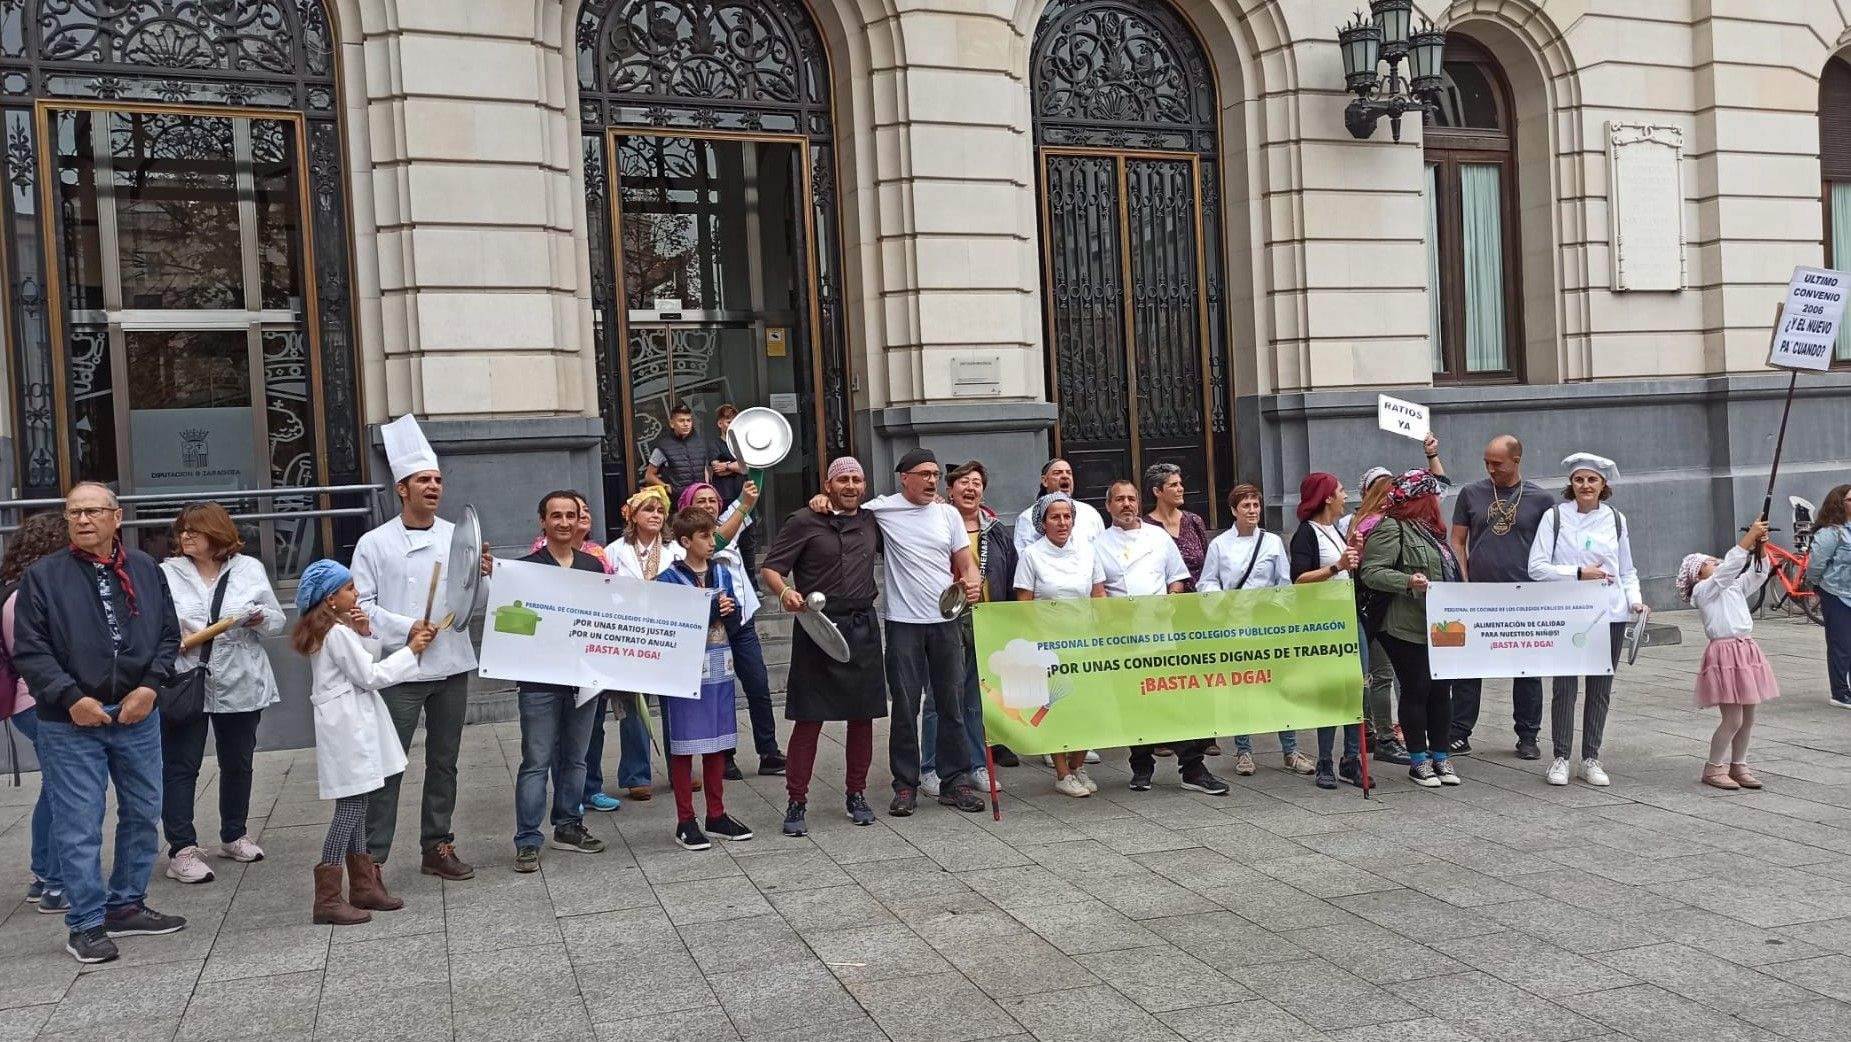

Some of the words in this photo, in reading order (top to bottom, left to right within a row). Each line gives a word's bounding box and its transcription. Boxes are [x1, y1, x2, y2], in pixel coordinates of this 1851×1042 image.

[1804, 274, 1838, 286] ULTIMO
[1794, 288, 1840, 301] CONVENIO
[1802, 304, 1824, 314] 2006
[1796, 319, 1806, 331] EL
[1806, 320, 1832, 334] NUEVO
[1792, 341, 1826, 357] CUANDO?
[1384, 402, 1422, 419] RATIOS
[1398, 420, 1410, 430] YA
[526, 602, 556, 612] PERSONAL
[566, 607, 592, 616] COCINAS
[614, 613, 641, 622] COLEGIOS
[573, 618, 592, 628] ¡POR
[594, 621, 615, 631] UNAS
[617, 624, 646, 634] RATIOS
[646, 627, 676, 638] JUSTAS!
[1037, 639, 1089, 650] PERSONAL
[1092, 637, 1104, 646] DE
[1106, 634, 1150, 645] COCINAS
[1152, 633, 1164, 642] DE
[1168, 632, 1186, 641] LOS
[1189, 629, 1236, 639] COLEGIOS
[1239, 626, 1286, 637] PÚBLICOS
[1288, 625, 1300, 633] DE
[1302, 620, 1345, 632] ARAGÓN
[569, 629, 588, 638] ¡POR
[590, 632, 602, 640] UN
[604, 634, 646, 645] CONTRATO
[648, 639, 677, 648] ANUAL!
[1490, 640, 1518, 650] ¡BASTA
[1520, 640, 1532, 648] YA
[1534, 640, 1554, 648] DGA!
[585, 644, 619, 655] ¡BASTA
[623, 648, 636, 657] YA
[638, 650, 661, 660] DGA!
[1047, 663, 1079, 678] ¡POR
[1083, 660, 1120, 672] UNAS
[1124, 653, 1216, 670] CONDICIONES
[1220, 649, 1270, 662] DIGNAS
[1274, 648, 1290, 659] DE
[1294, 643, 1358, 657] TRABAJO!
[1141, 675, 1200, 695] ¡BASTA
[1204, 672, 1227, 688] YA
[1231, 669, 1272, 686] DGA!
